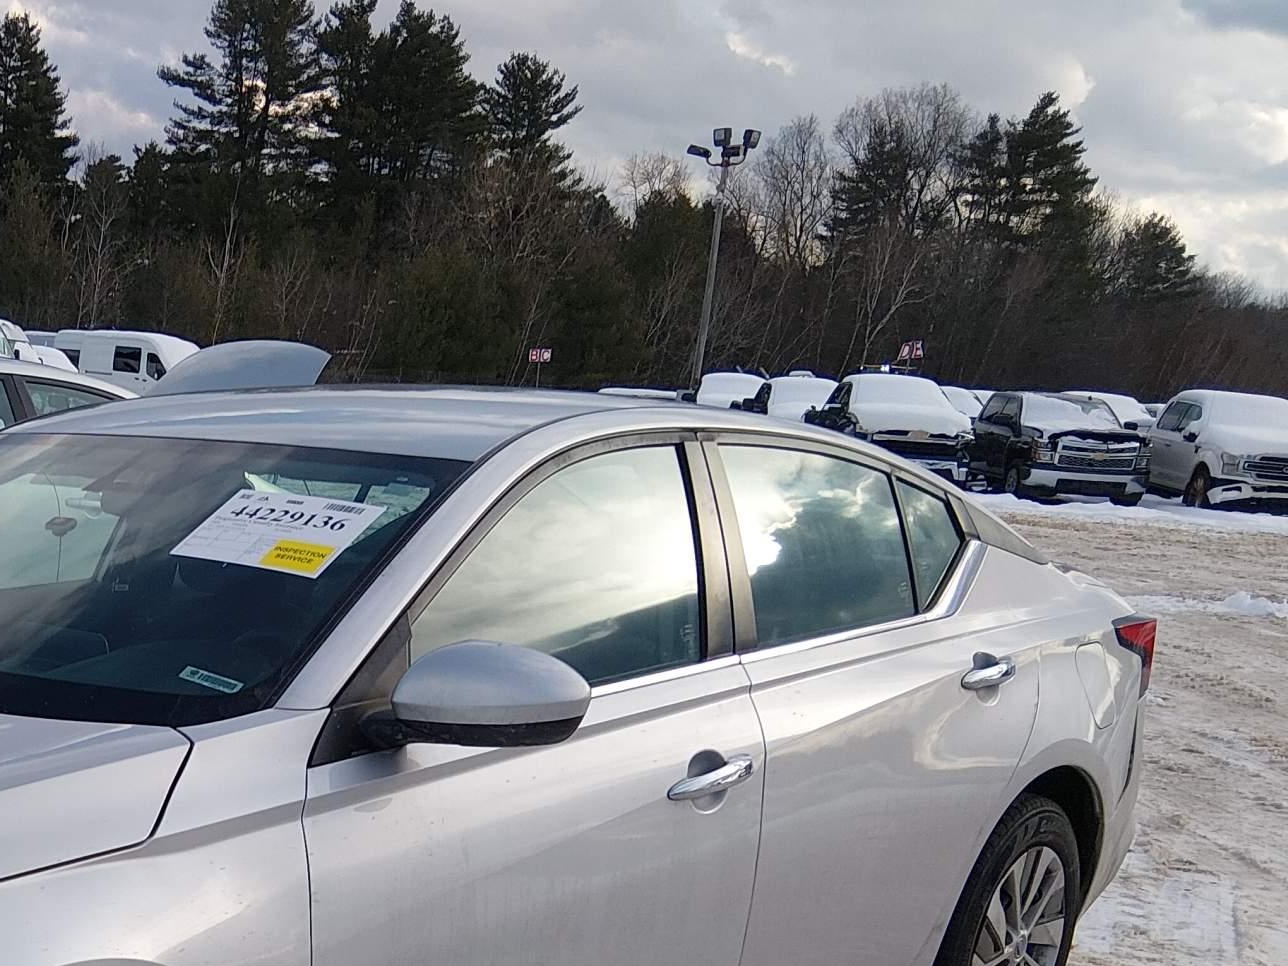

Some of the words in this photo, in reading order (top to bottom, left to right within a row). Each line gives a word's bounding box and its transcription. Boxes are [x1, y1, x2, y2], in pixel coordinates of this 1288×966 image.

[230, 504, 348, 532] 44229136
[273, 546, 327, 559] INSPECTION
[274, 554, 314, 564] SERVICE
